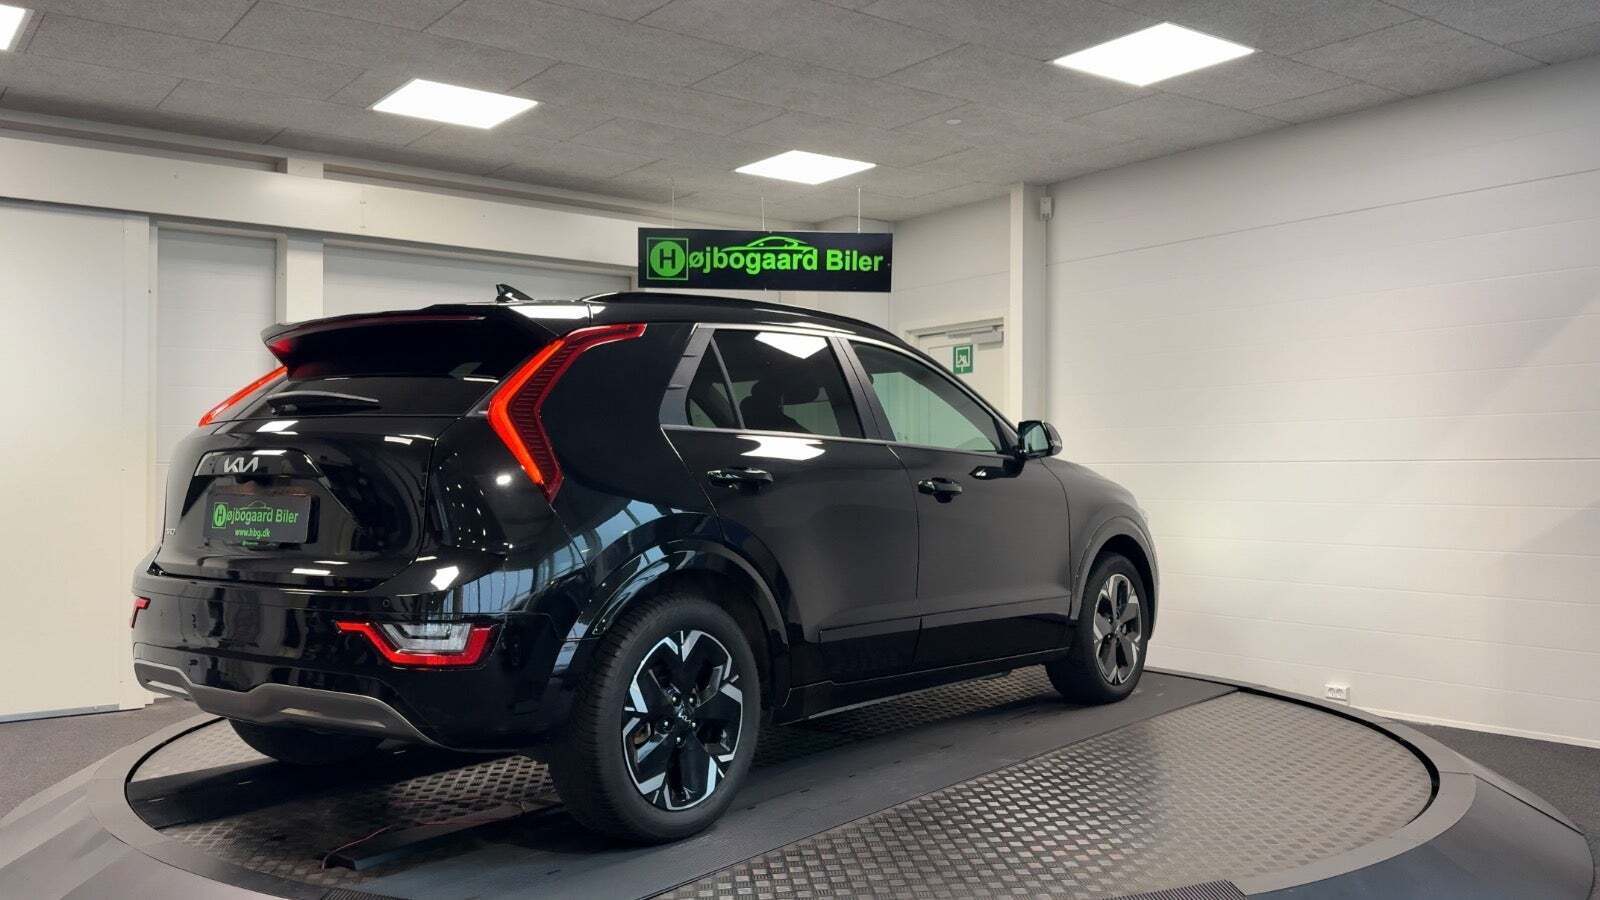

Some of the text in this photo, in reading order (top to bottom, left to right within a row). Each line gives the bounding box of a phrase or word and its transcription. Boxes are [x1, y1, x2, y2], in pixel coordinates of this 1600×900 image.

[650, 241, 884, 276] Højbogaard Biler
[223, 456, 259, 473] KIA
[275, 509, 299, 523] Biler
[235, 528, 271, 539] www.hbg.dk
